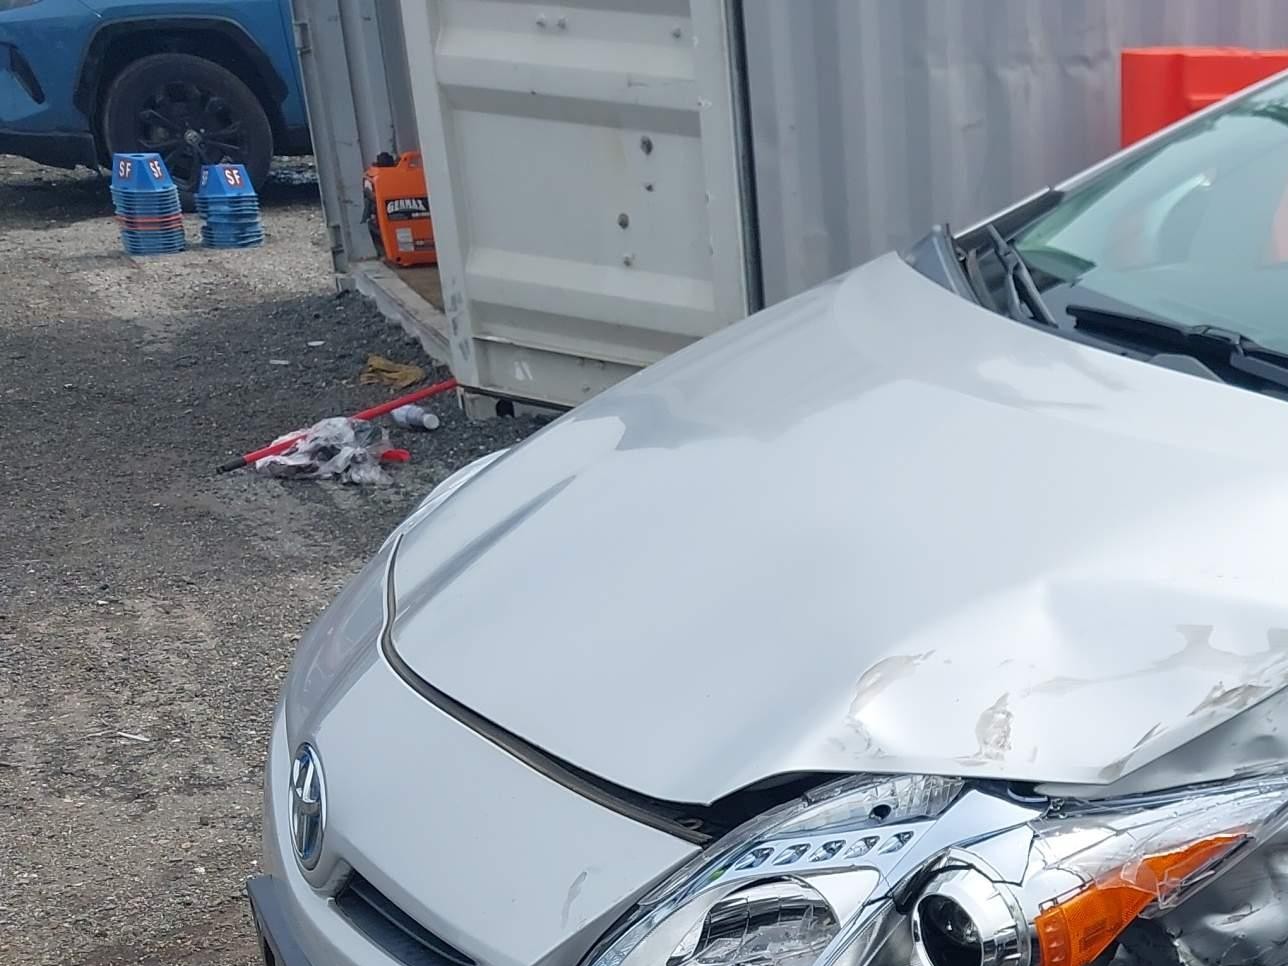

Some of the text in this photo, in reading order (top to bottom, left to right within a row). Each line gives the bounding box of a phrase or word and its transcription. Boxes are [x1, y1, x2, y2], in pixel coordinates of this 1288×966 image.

[119, 160, 132, 178] SF
[150, 160, 163, 178] SF
[224, 169, 241, 185] SF
